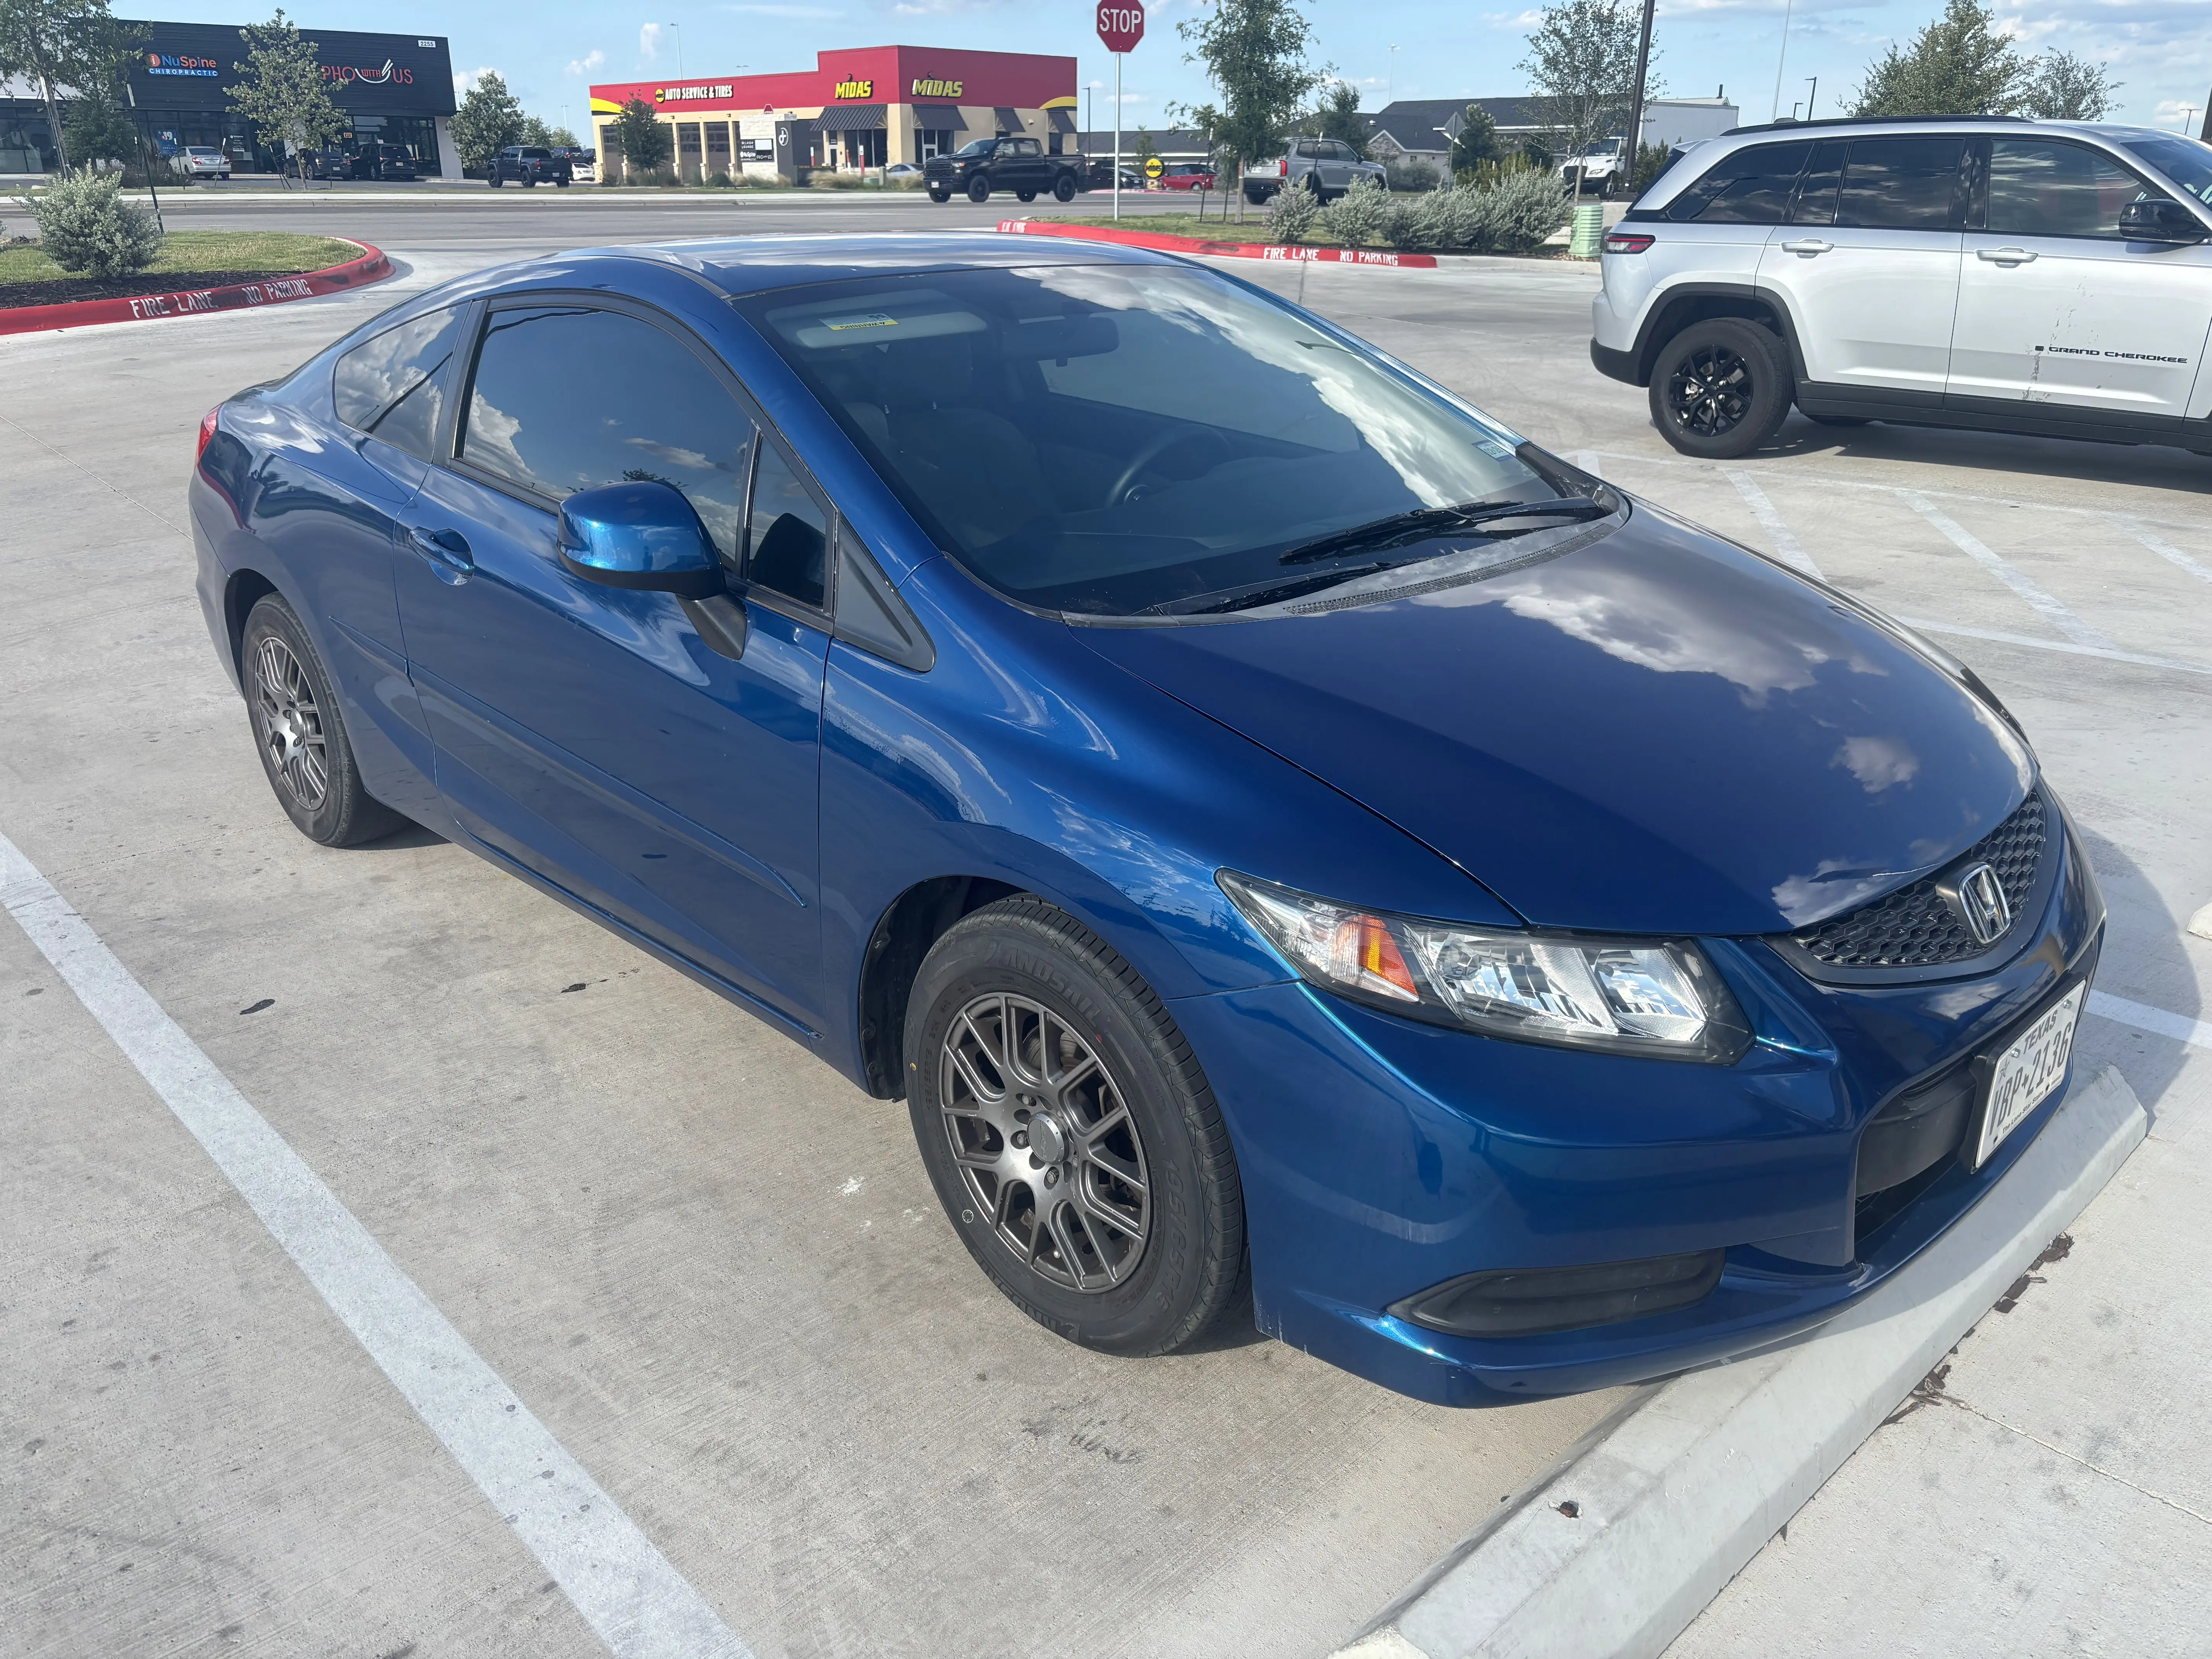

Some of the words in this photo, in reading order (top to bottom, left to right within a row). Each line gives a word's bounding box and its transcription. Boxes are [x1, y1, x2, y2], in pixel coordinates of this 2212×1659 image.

[1099, 8, 1141, 33] STOP
[161, 55, 216, 69] NuSpine
[321, 65, 356, 81] PHO
[361, 69, 381, 77] WITH
[393, 69, 413, 84] US
[665, 88, 680, 100] AUTO
[682, 86, 708, 99] SERVICE
[709, 86, 714, 98] &
[715, 85, 732, 97] TIRES
[835, 81, 872, 98] MIDAS
[912, 79, 963, 97] MIDAS
[1263, 247, 1288, 259] FIRE
[1292, 248, 1320, 261] LANE
[1340, 251, 1353, 262] NO
[1358, 252, 1398, 266] PARKING
[129, 297, 171, 318] FIRE
[173, 292, 218, 311] LANE
[242, 286, 263, 304] NO
[264, 279, 313, 300] PARKING
[2049, 347, 2100, 356] GRAND
[2104, 351, 2188, 363] CHEROKEE
[2023, 1010, 2058, 1054] TEXAS
[1989, 1066, 2023, 1136] VBP
[2025, 1022, 2072, 1099] 2136
[2011, 1112, 2022, 1124] Lone
[2022, 1103, 2032, 1114] Star
[2032, 1091, 2044, 1104] State
